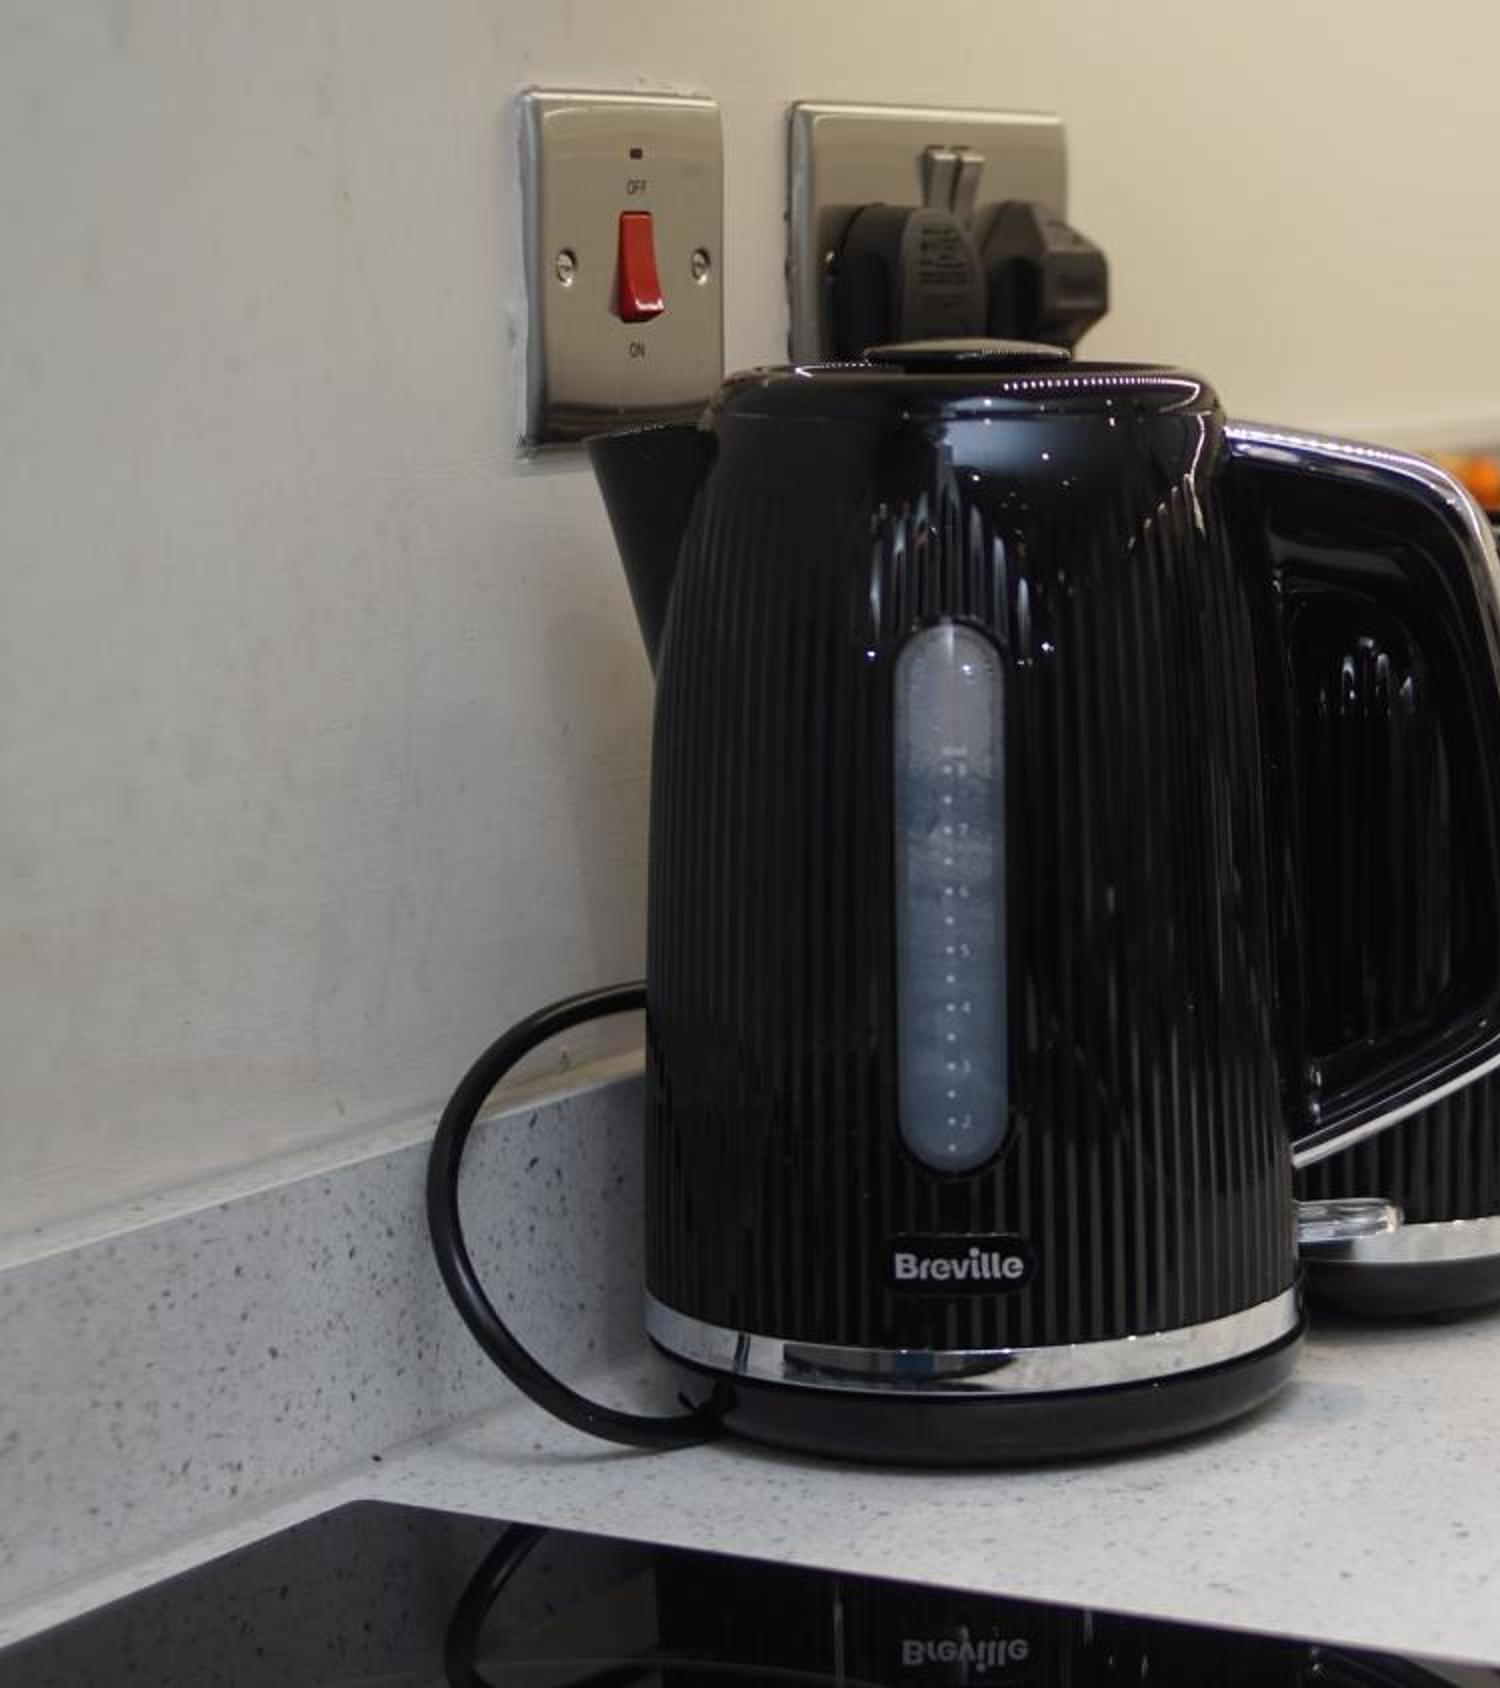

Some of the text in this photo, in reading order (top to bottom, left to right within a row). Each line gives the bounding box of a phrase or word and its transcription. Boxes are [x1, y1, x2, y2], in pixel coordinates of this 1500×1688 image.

[626, 180, 647, 195] OFF
[629, 343, 645, 358] ON
[895, 1247, 1025, 1280] Breville
